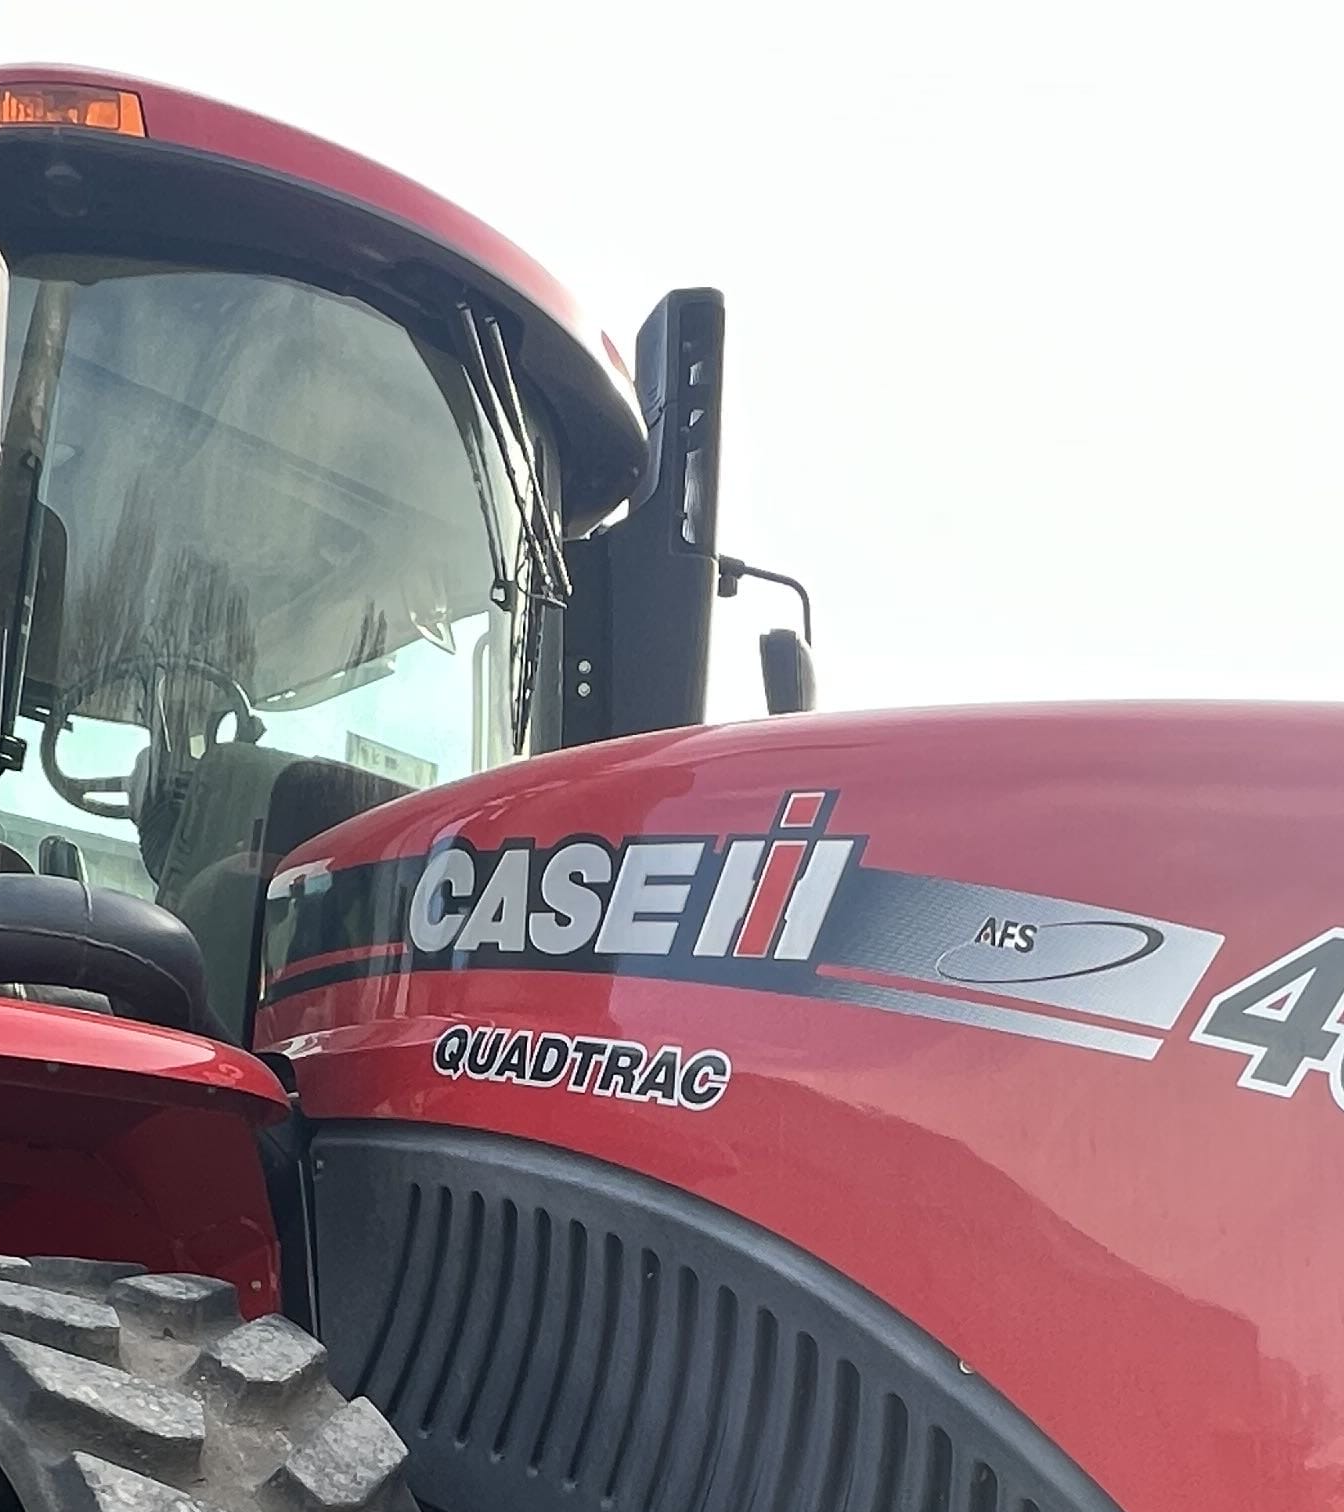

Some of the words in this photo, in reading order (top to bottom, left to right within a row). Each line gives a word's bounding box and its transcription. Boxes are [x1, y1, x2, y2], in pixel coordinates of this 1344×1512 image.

[408, 841, 706, 956] CASE
[974, 916, 1038, 954] AFS
[434, 1024, 732, 1111] QUADTRAC
